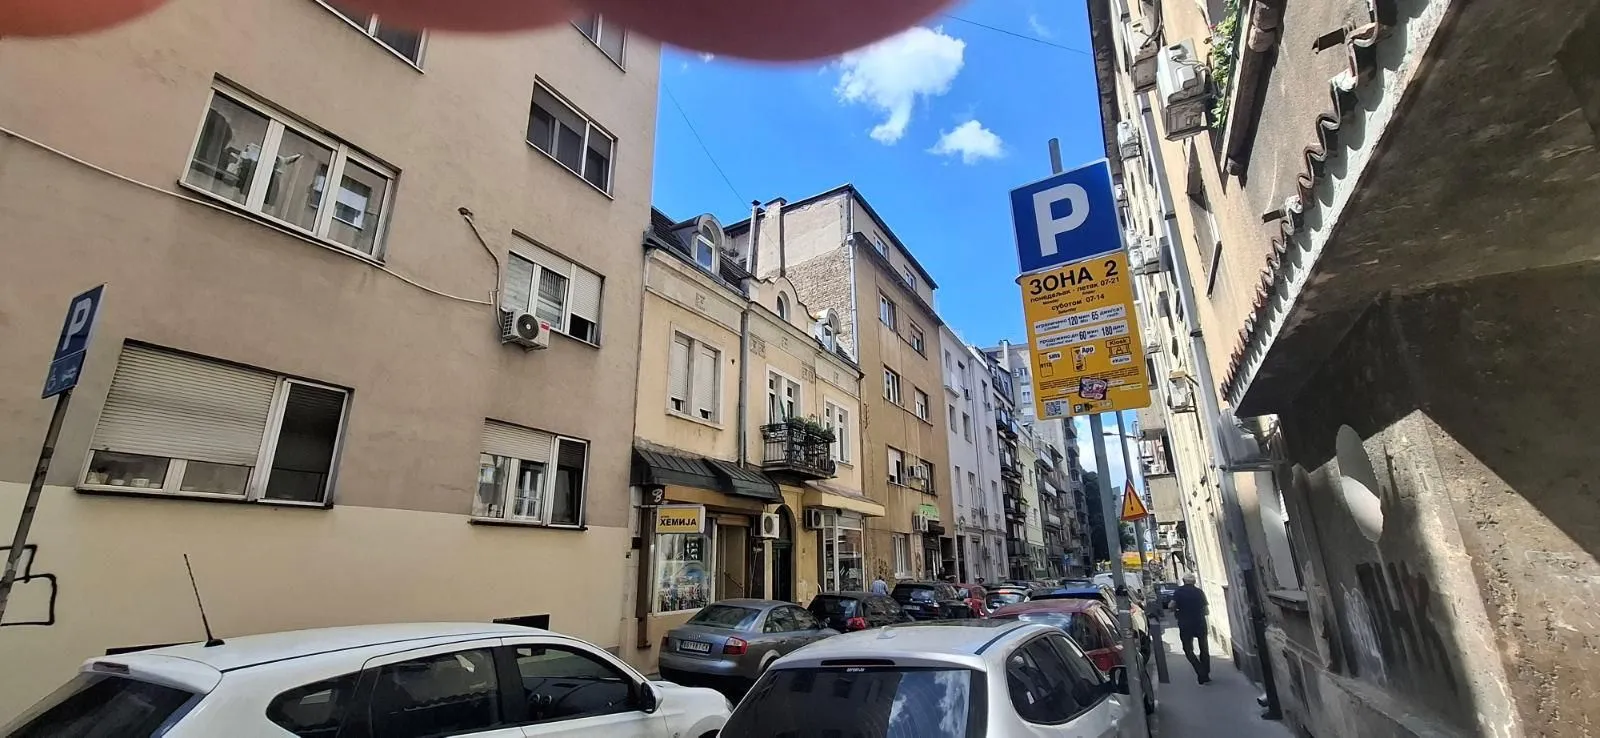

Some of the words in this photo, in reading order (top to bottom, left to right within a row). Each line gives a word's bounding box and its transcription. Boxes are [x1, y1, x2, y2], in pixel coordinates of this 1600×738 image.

[1033, 183, 1090, 257] P
[1029, 266, 1093, 295] ЗОНА
[1104, 260, 1118, 277] 2
[62, 297, 92, 351] P
[660, 518, 697, 527] ХЕМИЈА
